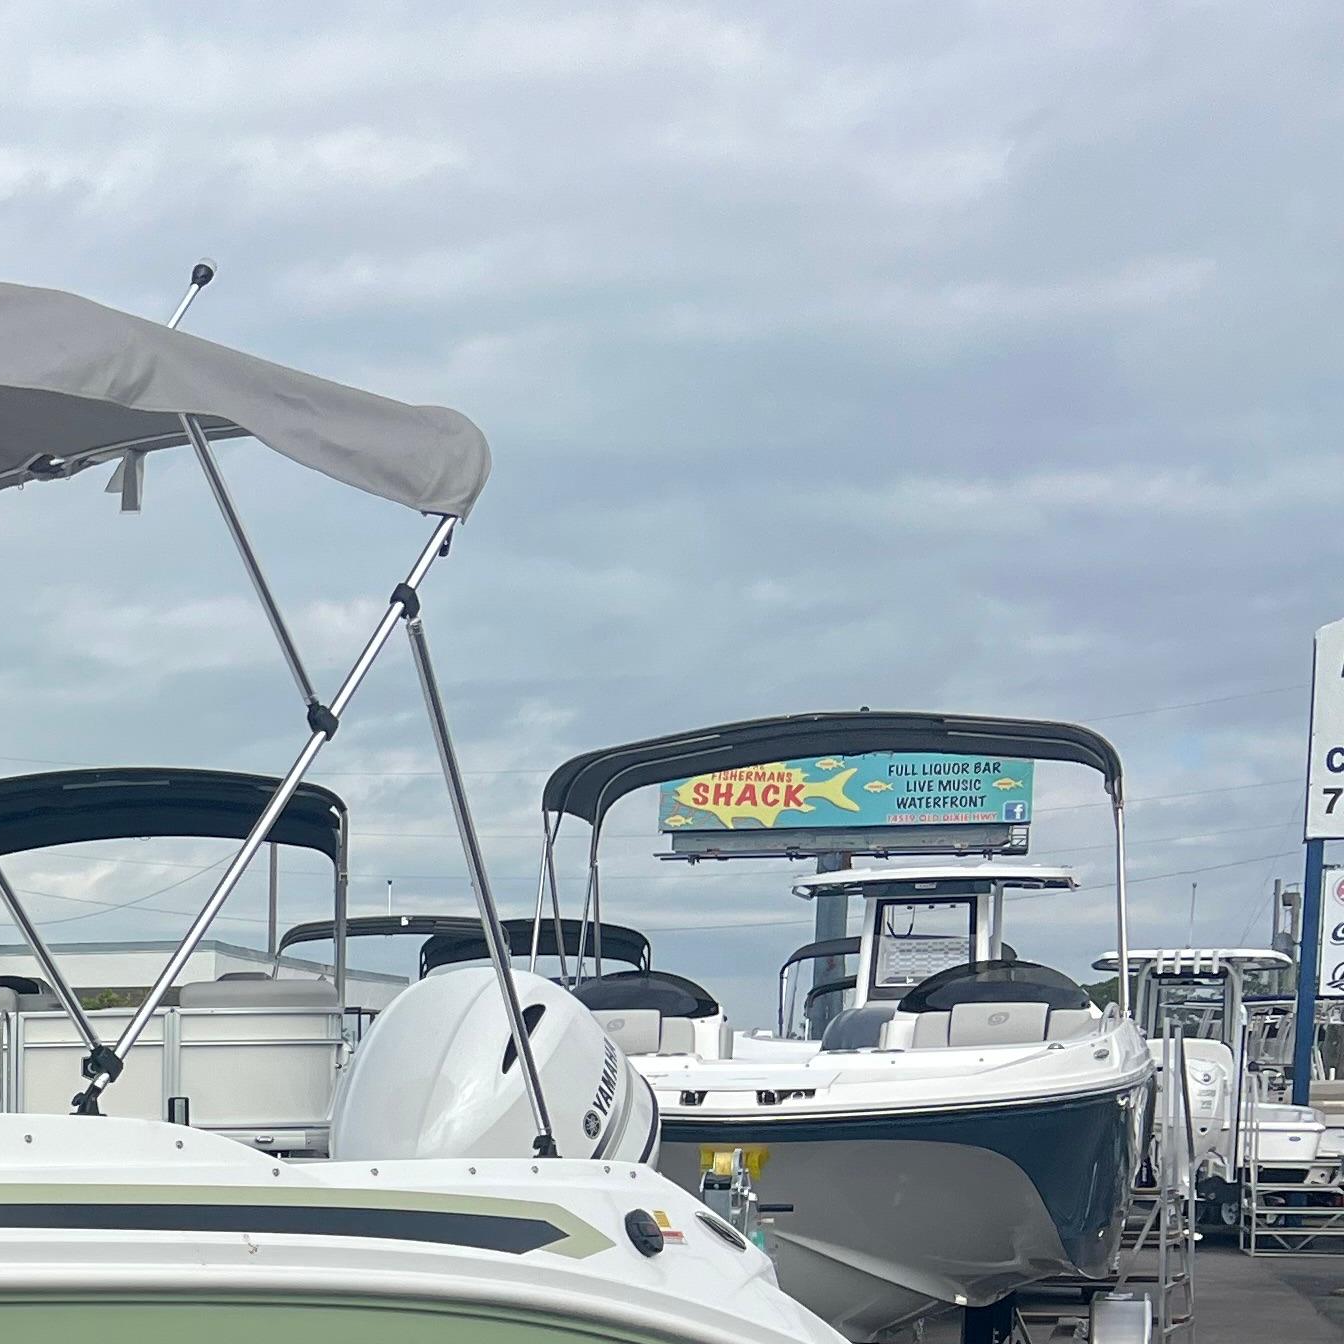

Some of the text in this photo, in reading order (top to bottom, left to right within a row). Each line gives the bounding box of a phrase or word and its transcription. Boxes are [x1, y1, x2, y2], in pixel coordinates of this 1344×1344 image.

[888, 761, 1002, 776] FULL LIQUOR BAR
[711, 769, 793, 783] FISHERMANS
[906, 778, 982, 792] LIVE MUSIC
[692, 782, 806, 808] SHACK
[896, 795, 987, 809] WATERFRONT
[592, 1036, 618, 1116] YAMAHA
